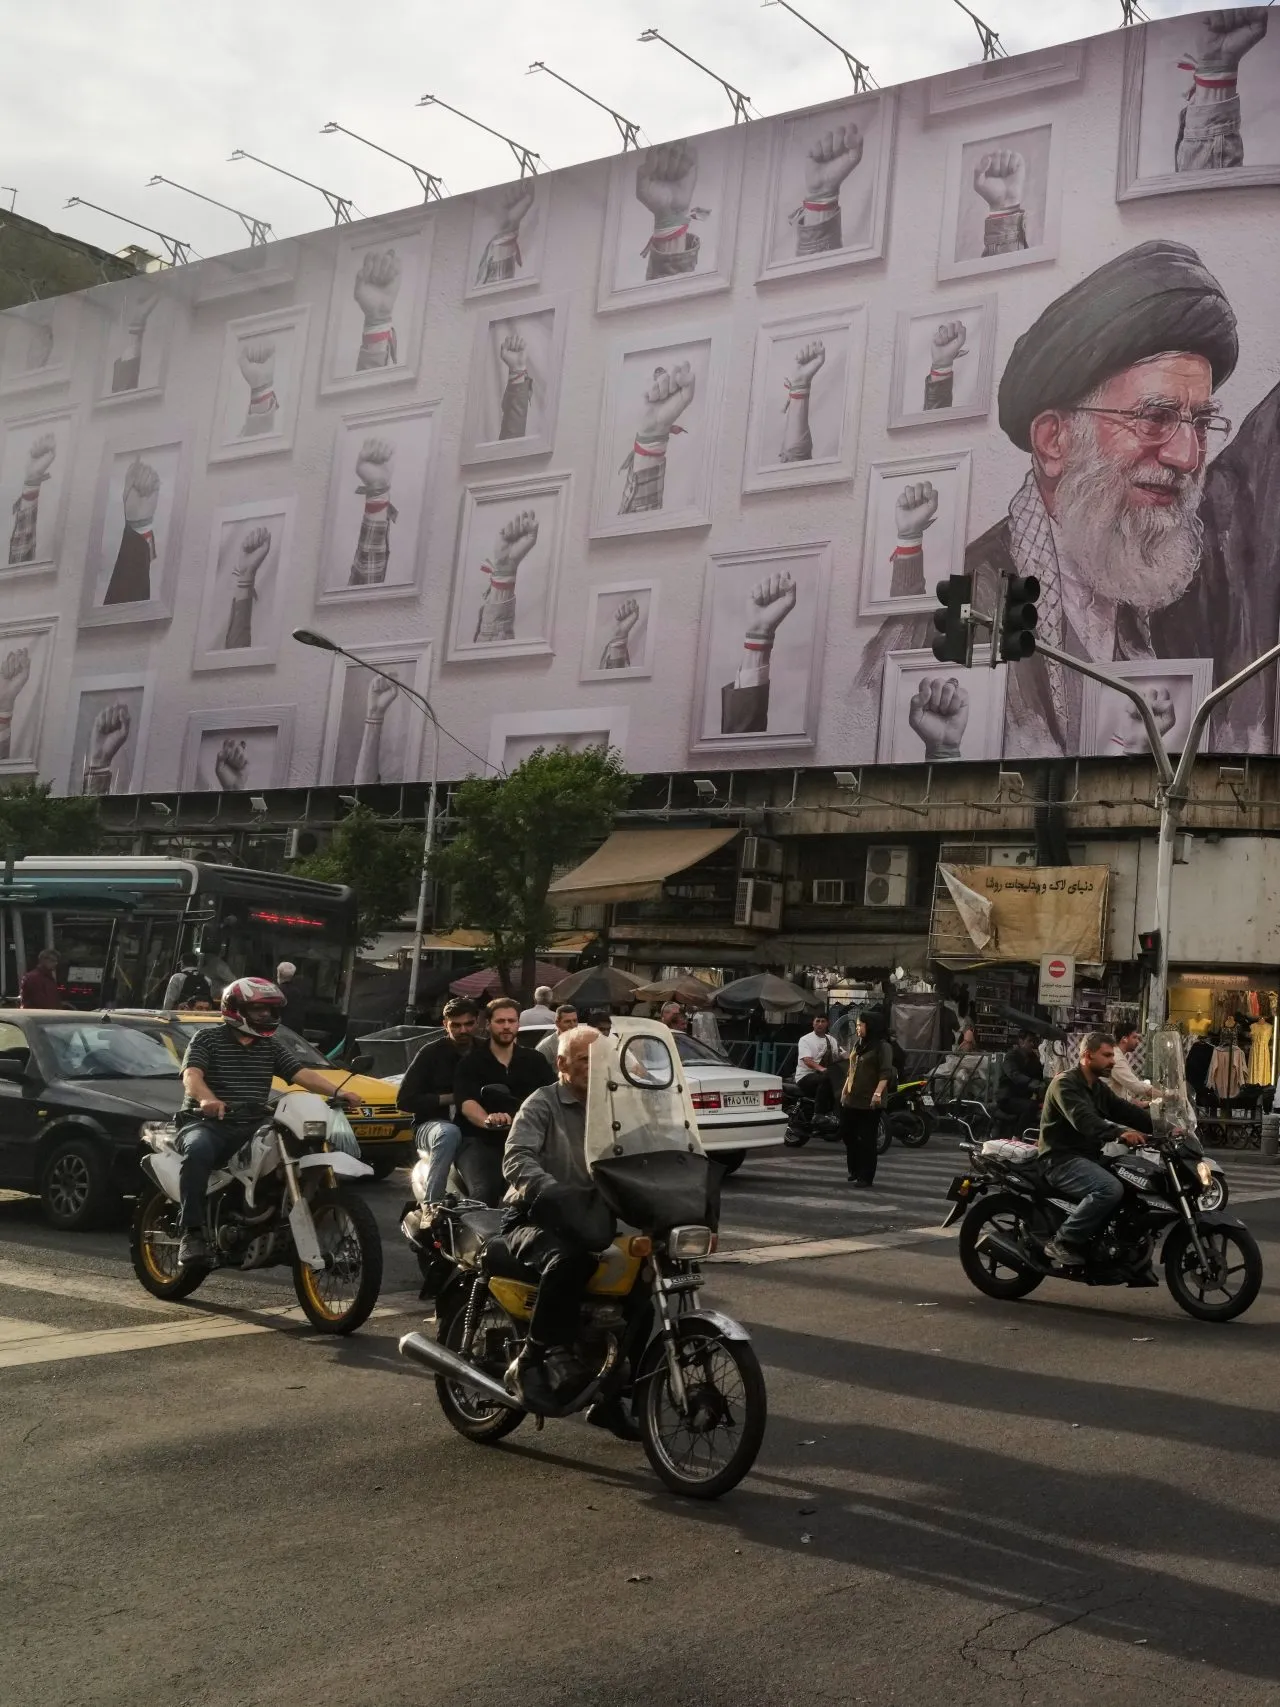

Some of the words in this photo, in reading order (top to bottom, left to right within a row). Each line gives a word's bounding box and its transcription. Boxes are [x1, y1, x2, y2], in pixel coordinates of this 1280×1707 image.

[1049, 879, 1067, 891] لاک
[1068, 879, 1094, 894] دنیای
[1117, 1166, 1149, 1187] Benelli
